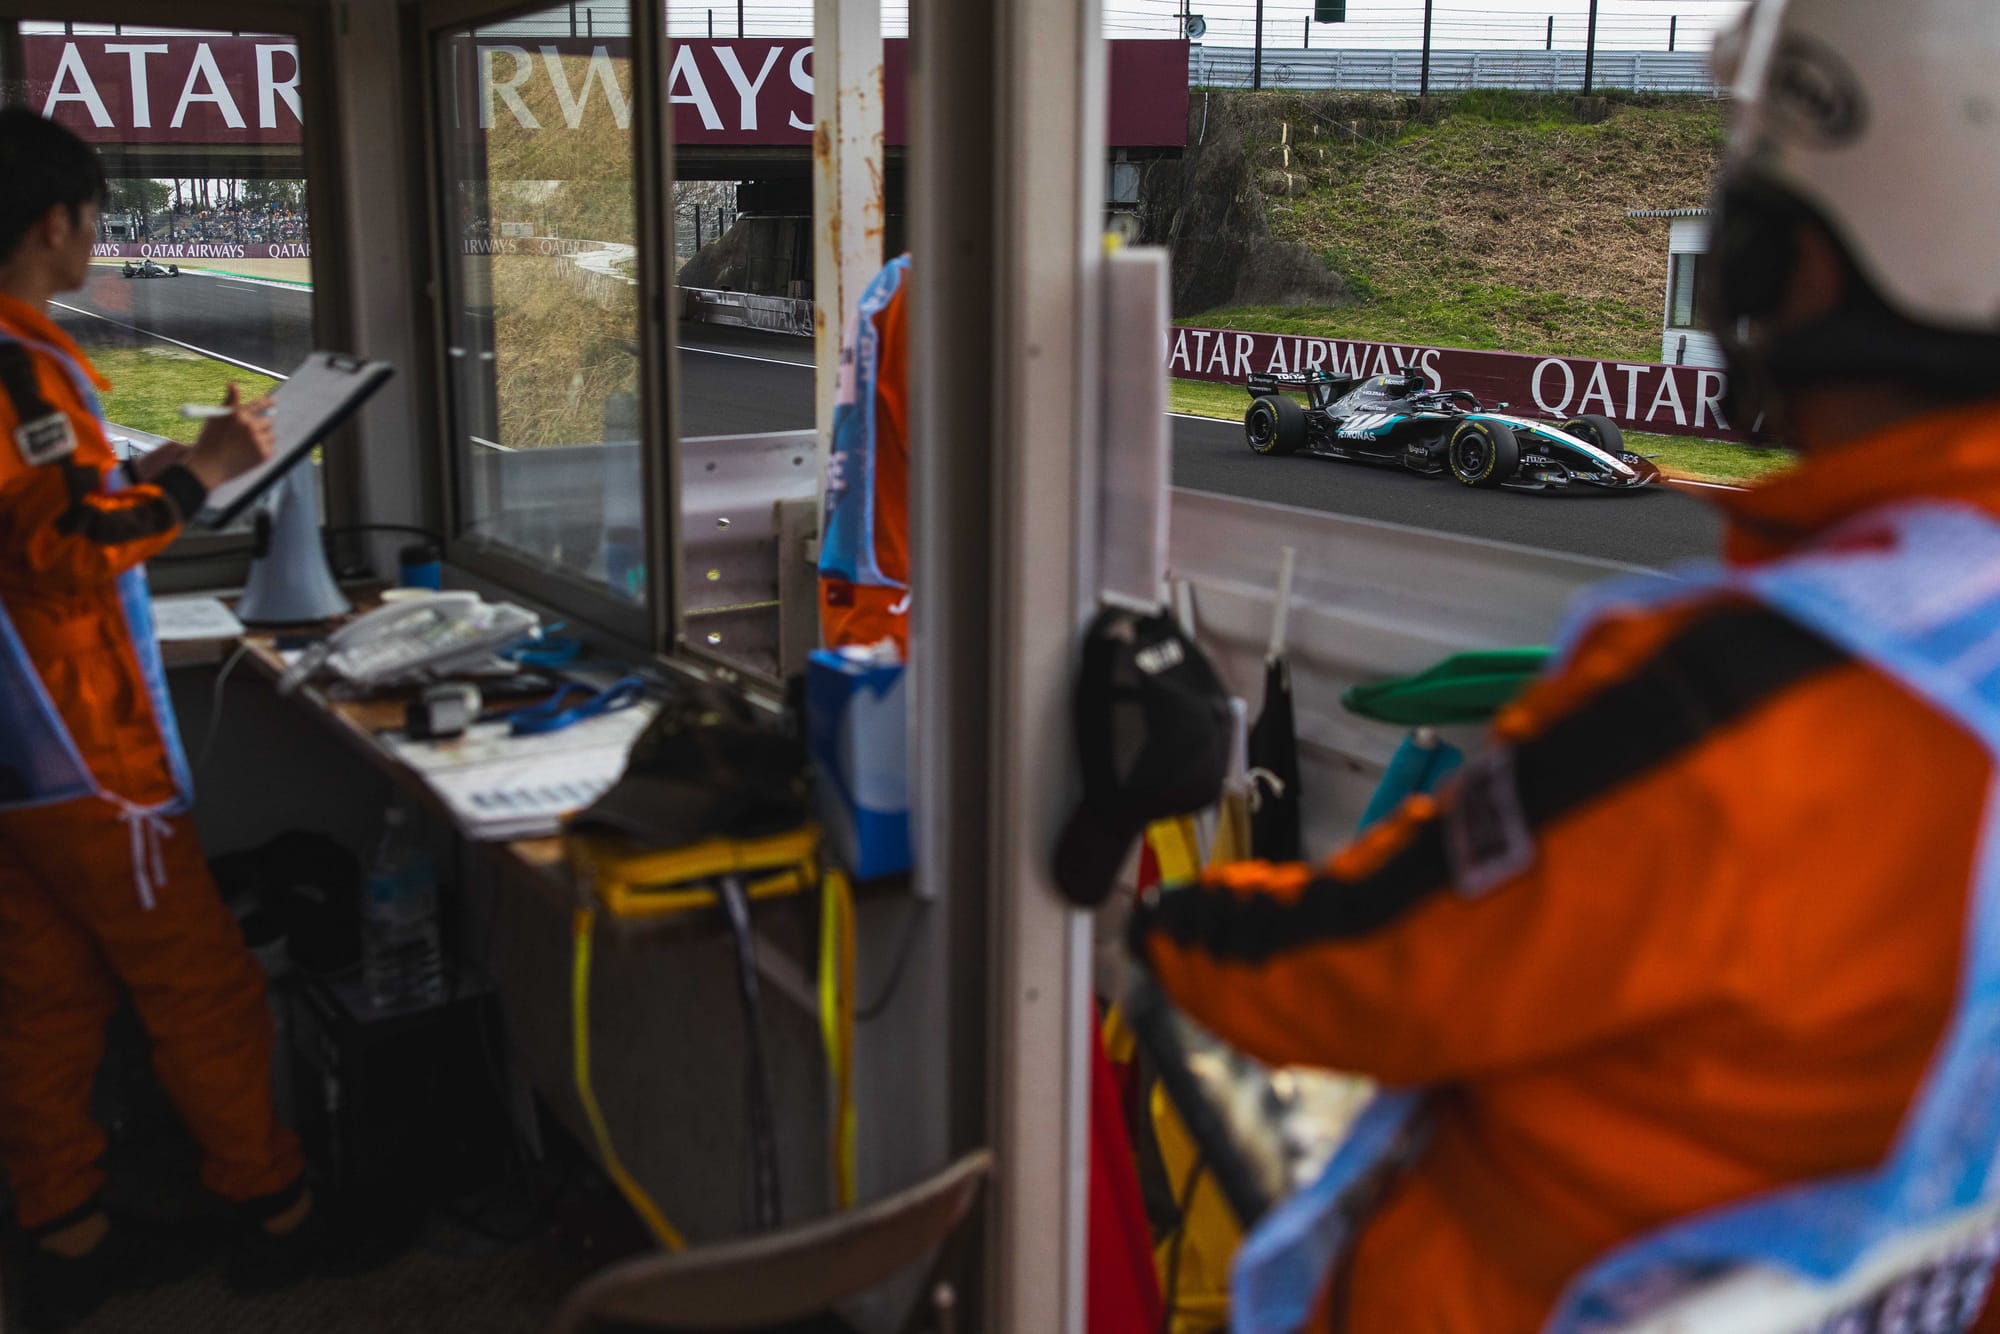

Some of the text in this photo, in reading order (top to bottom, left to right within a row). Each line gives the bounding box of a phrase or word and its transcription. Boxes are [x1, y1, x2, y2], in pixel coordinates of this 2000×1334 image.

[140, 243, 245, 259] QATAR AIRWAYS
[540, 239, 580, 255] QATAR
[1164, 328, 1442, 393] ATAR AIRWAYS
[1531, 358, 1732, 430] QATAR
